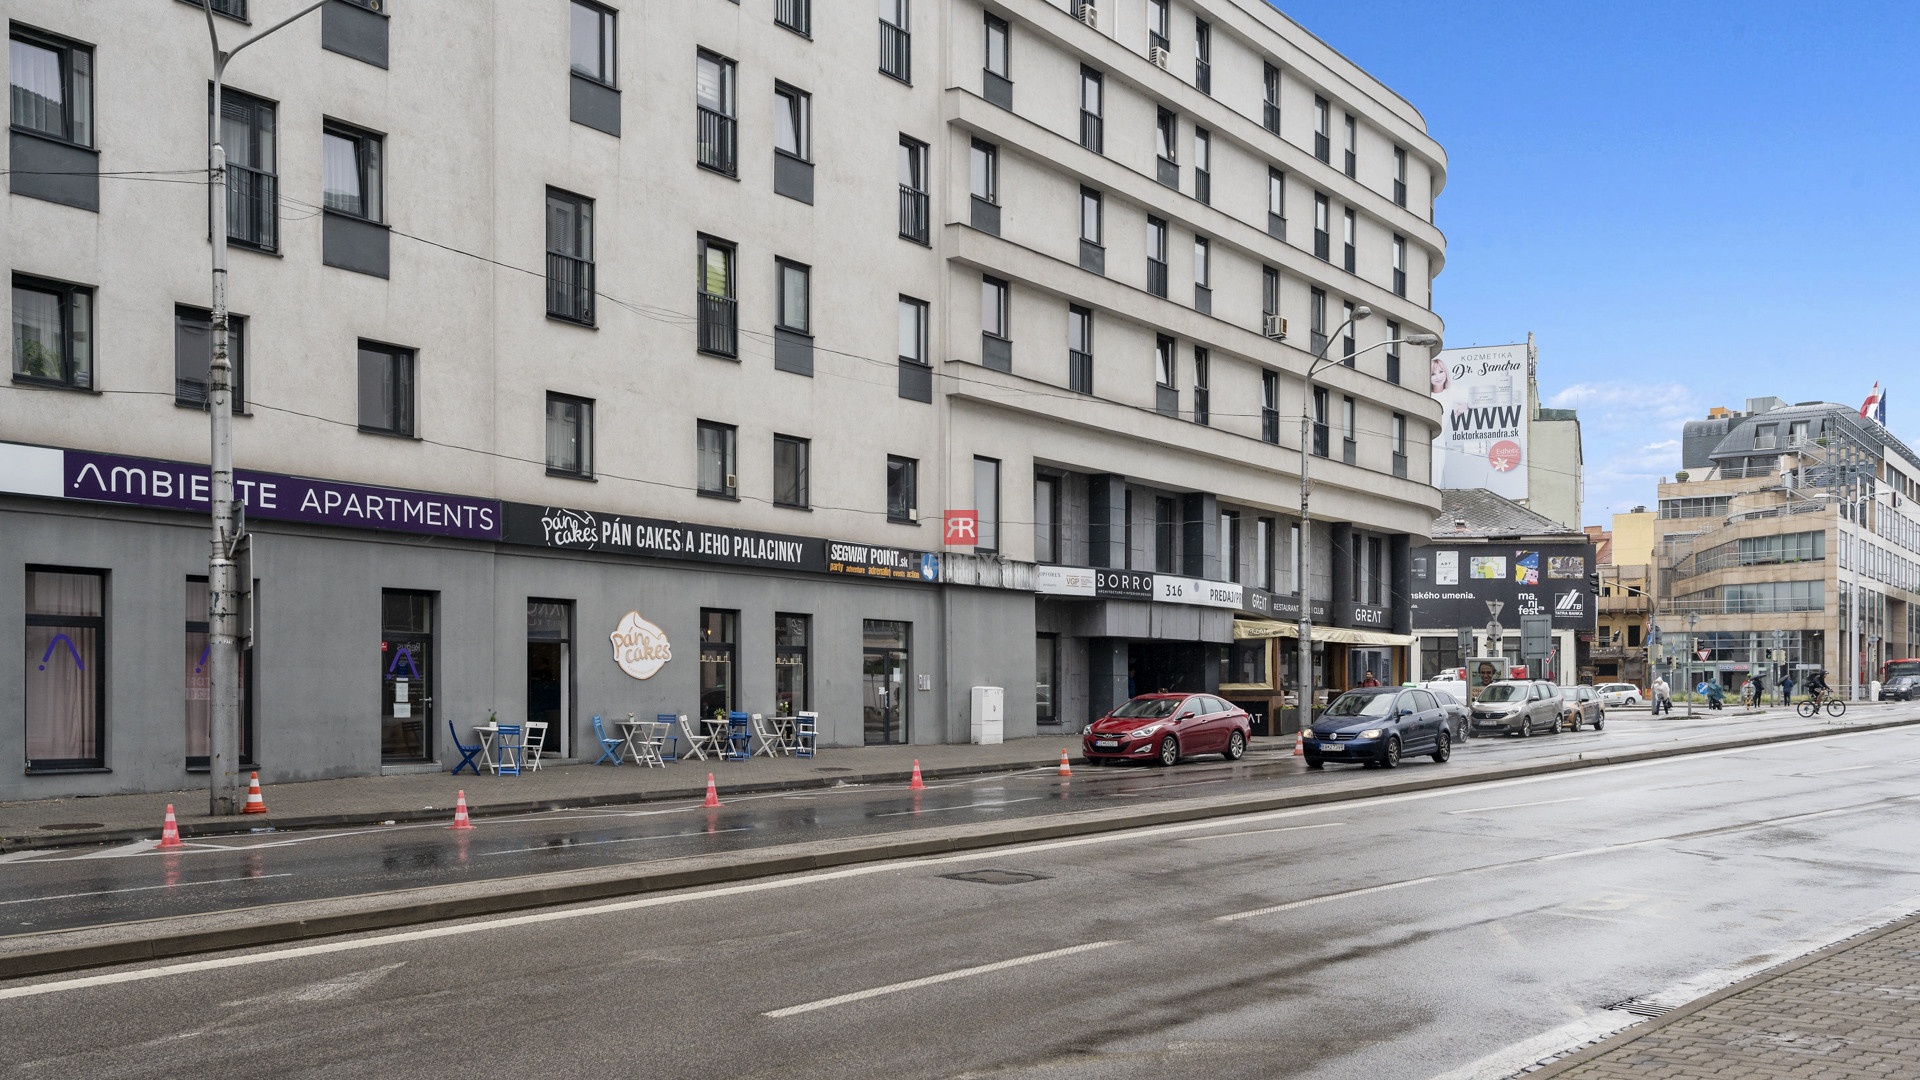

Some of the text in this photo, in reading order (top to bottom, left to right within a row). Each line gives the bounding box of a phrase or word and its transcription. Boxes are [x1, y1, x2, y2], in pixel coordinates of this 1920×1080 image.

[1460, 352, 1513, 361] KOZMETIKA
[1452, 360, 1521, 380] Dr. Sandra
[1452, 428, 1519, 441] doktorkasandra.sk
[73, 462, 494, 531] AMBIETE APARTMENTS
[602, 517, 803, 563] PÁN CAKES A JEHO PALACINKY
[830, 543, 868, 564] SEGWAY
[829, 562, 844, 572] party
[846, 565, 866, 574] adventure
[868, 566, 891, 576] adrenalin
[906, 570, 920, 578] action
[1097, 573, 1152, 591] BORRO
[1166, 584, 1183, 597] 316
[1441, 591, 1476, 599] umenia.
[1252, 593, 1267, 611] GREAT
[1273, 602, 1299, 612] RESTAURANT
[1313, 606, 1324, 615] CLUB
[1355, 608, 1382, 623] GREAT
[1518, 605, 1539, 615] fest
